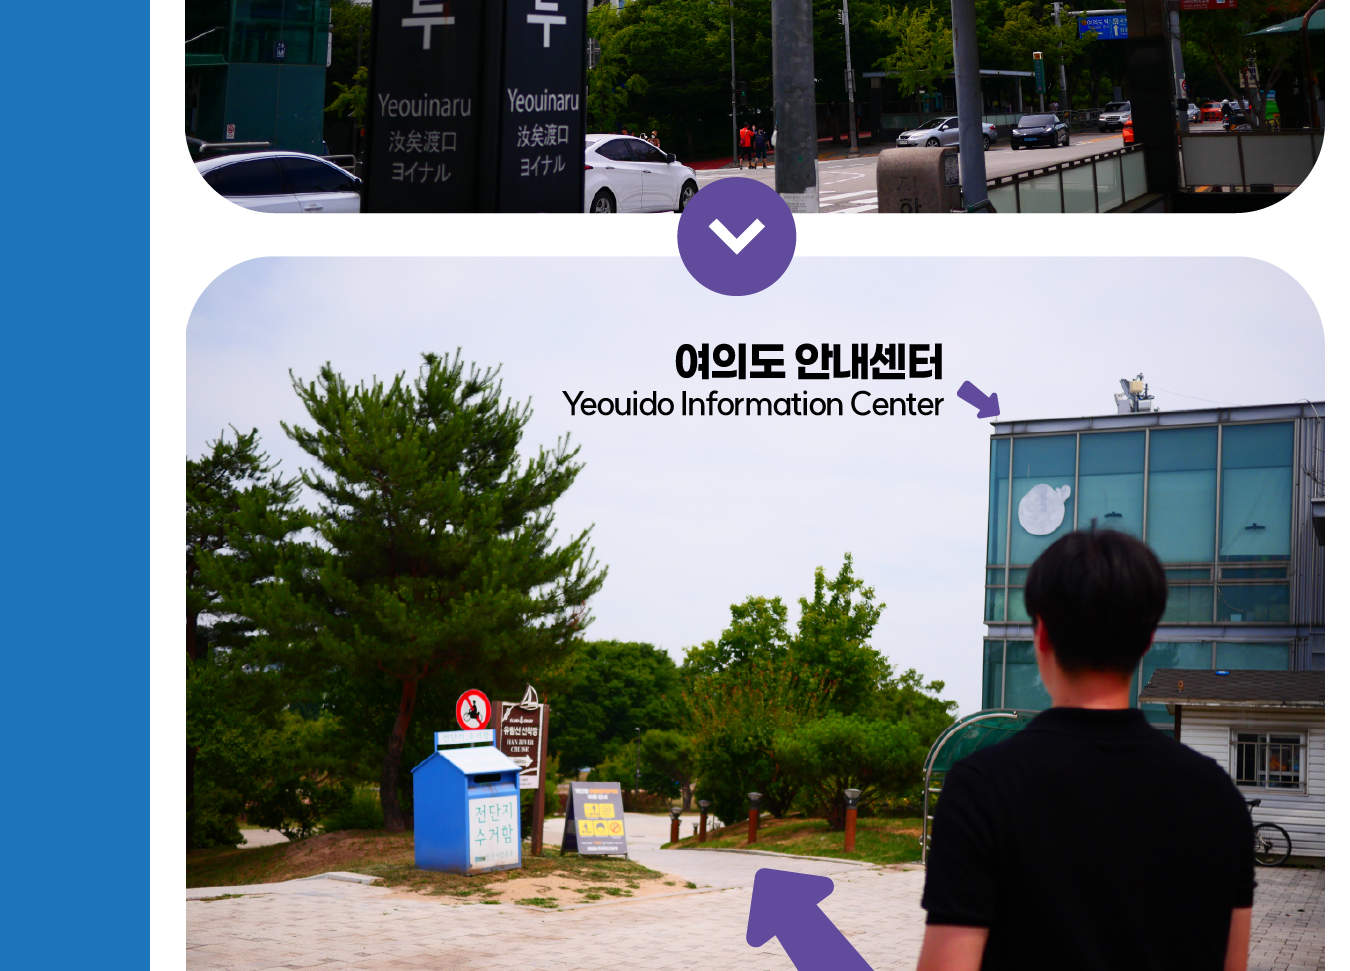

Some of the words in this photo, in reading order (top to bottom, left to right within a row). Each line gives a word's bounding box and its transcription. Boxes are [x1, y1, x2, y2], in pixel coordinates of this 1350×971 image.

[378, 92, 472, 117] Yeouinaru
[507, 88, 579, 113] Yeouinaru
[388, 129, 457, 153] 汝矣渡口
[517, 123, 569, 147] 汝矣渡口
[391, 161, 452, 184] ヨイナル
[520, 154, 567, 177] ヨイナル
[475, 802, 513, 824] 전단지
[474, 824, 513, 846] 수거함
